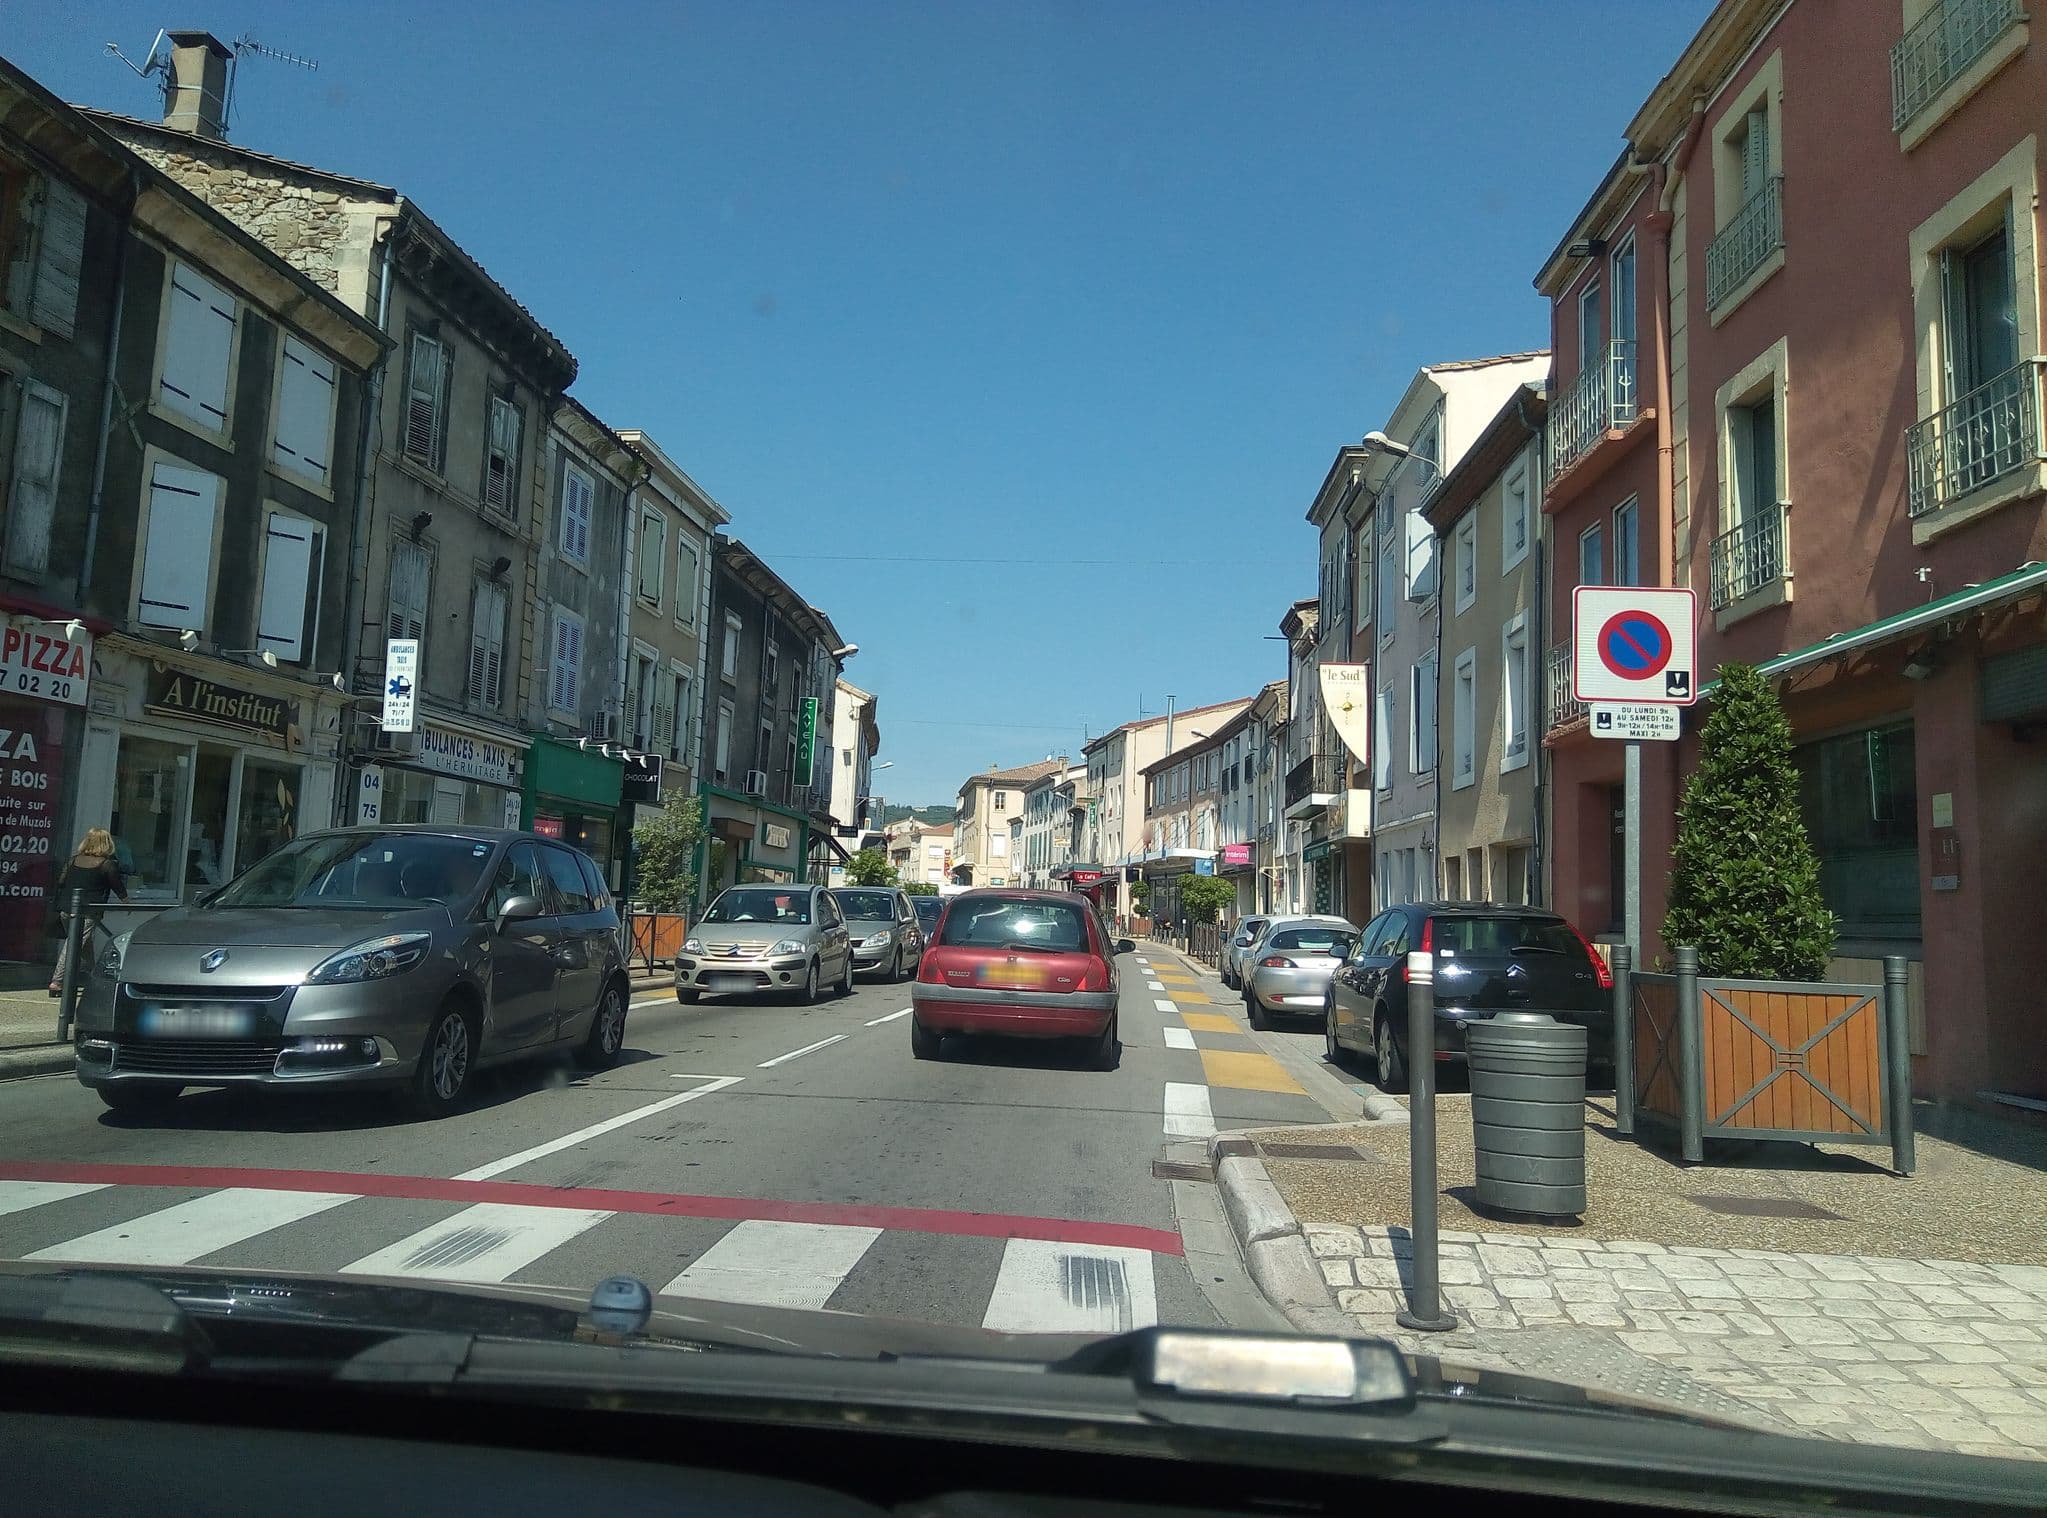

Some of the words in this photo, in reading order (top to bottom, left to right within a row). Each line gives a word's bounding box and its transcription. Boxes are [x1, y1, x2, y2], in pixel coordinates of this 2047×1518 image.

[2, 628, 84, 680] PIZZA
[18, 674, 40, 693] 02
[51, 681, 70, 698] 20
[163, 677, 183, 706] A
[1621, 706, 1632, 714] DU
[800, 701, 814, 760] CAVEAU
[483, 744, 506, 768] TAXIS
[436, 757, 501, 779] L'HERMITAGE
[11, 769, 48, 790] BOIS
[364, 774, 380, 790] 04
[27, 801, 46, 811] sur
[362, 803, 377, 819] 75
[5, 813, 17, 826] de
[19, 815, 51, 829] Muzols
